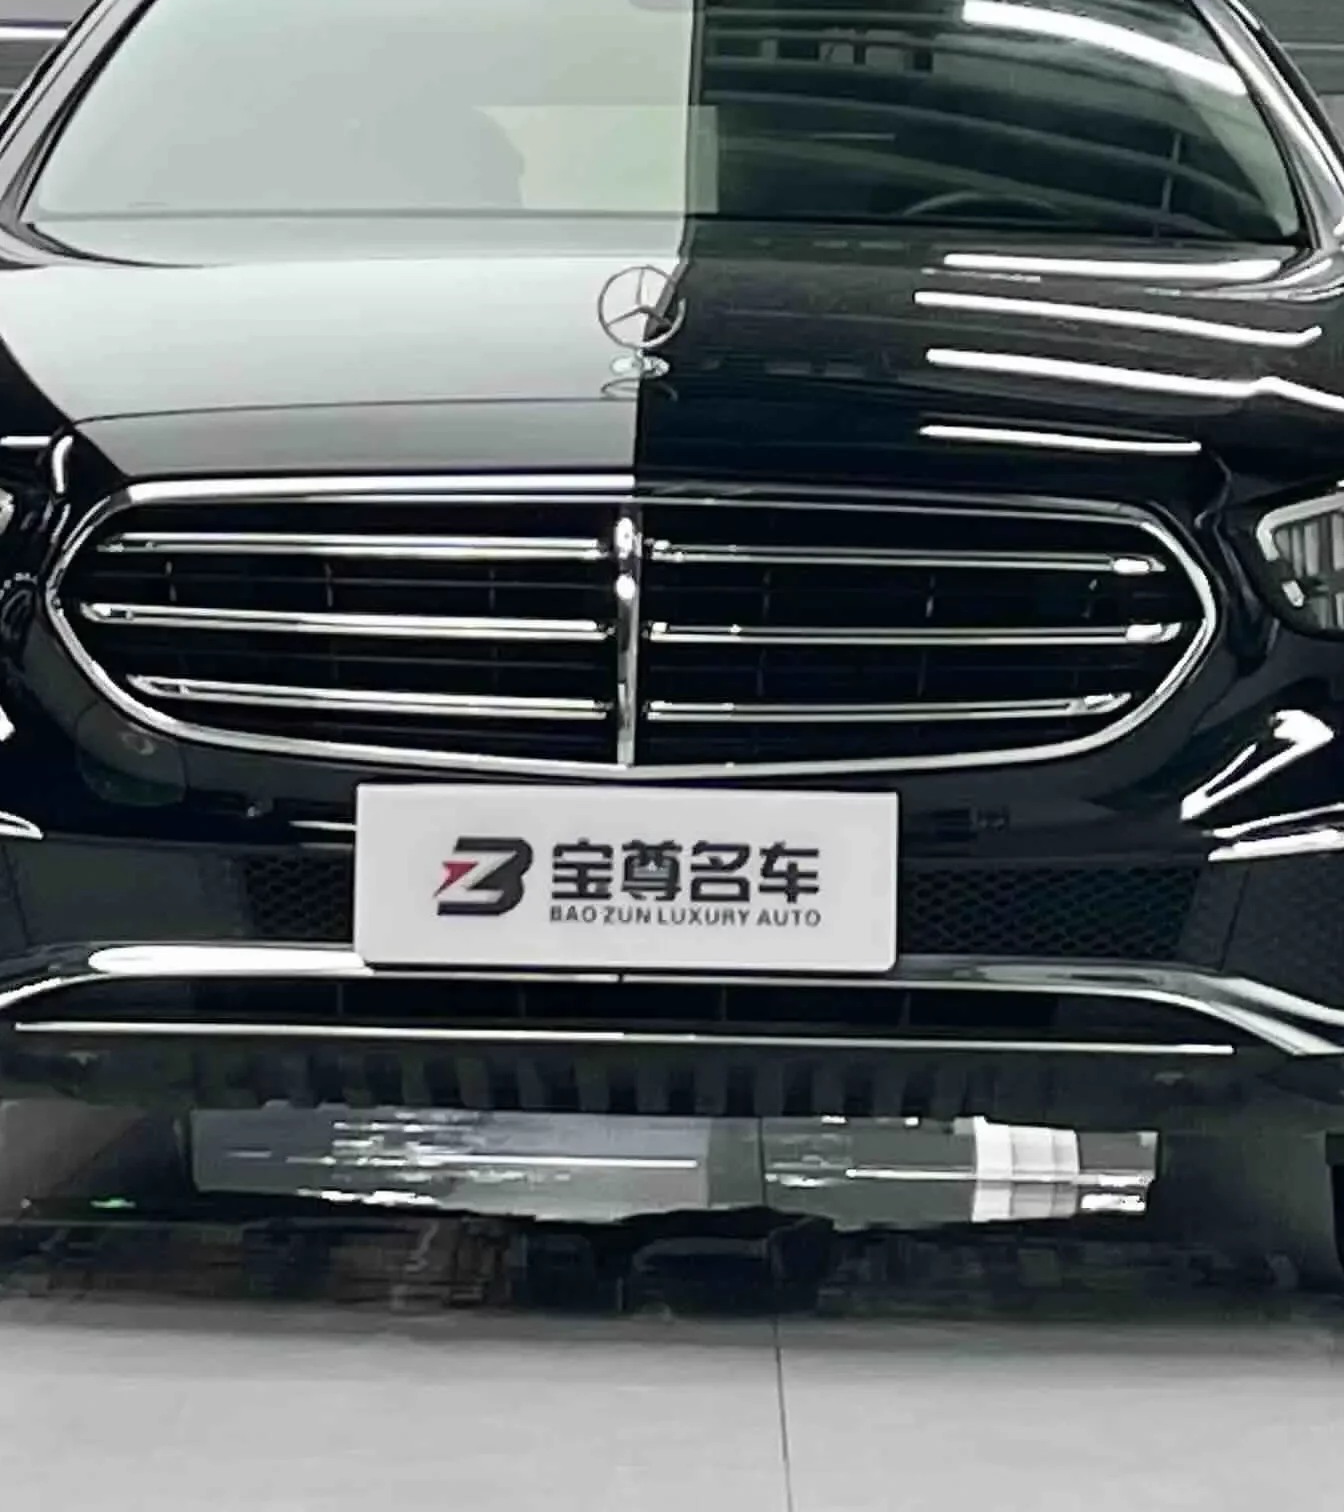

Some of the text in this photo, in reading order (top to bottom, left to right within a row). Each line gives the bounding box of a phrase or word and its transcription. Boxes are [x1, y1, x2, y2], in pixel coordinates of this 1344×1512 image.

[551, 838, 820, 904] 宝尊名车
[550, 905, 822, 927] BAO ZUN LUXURY AUTO
